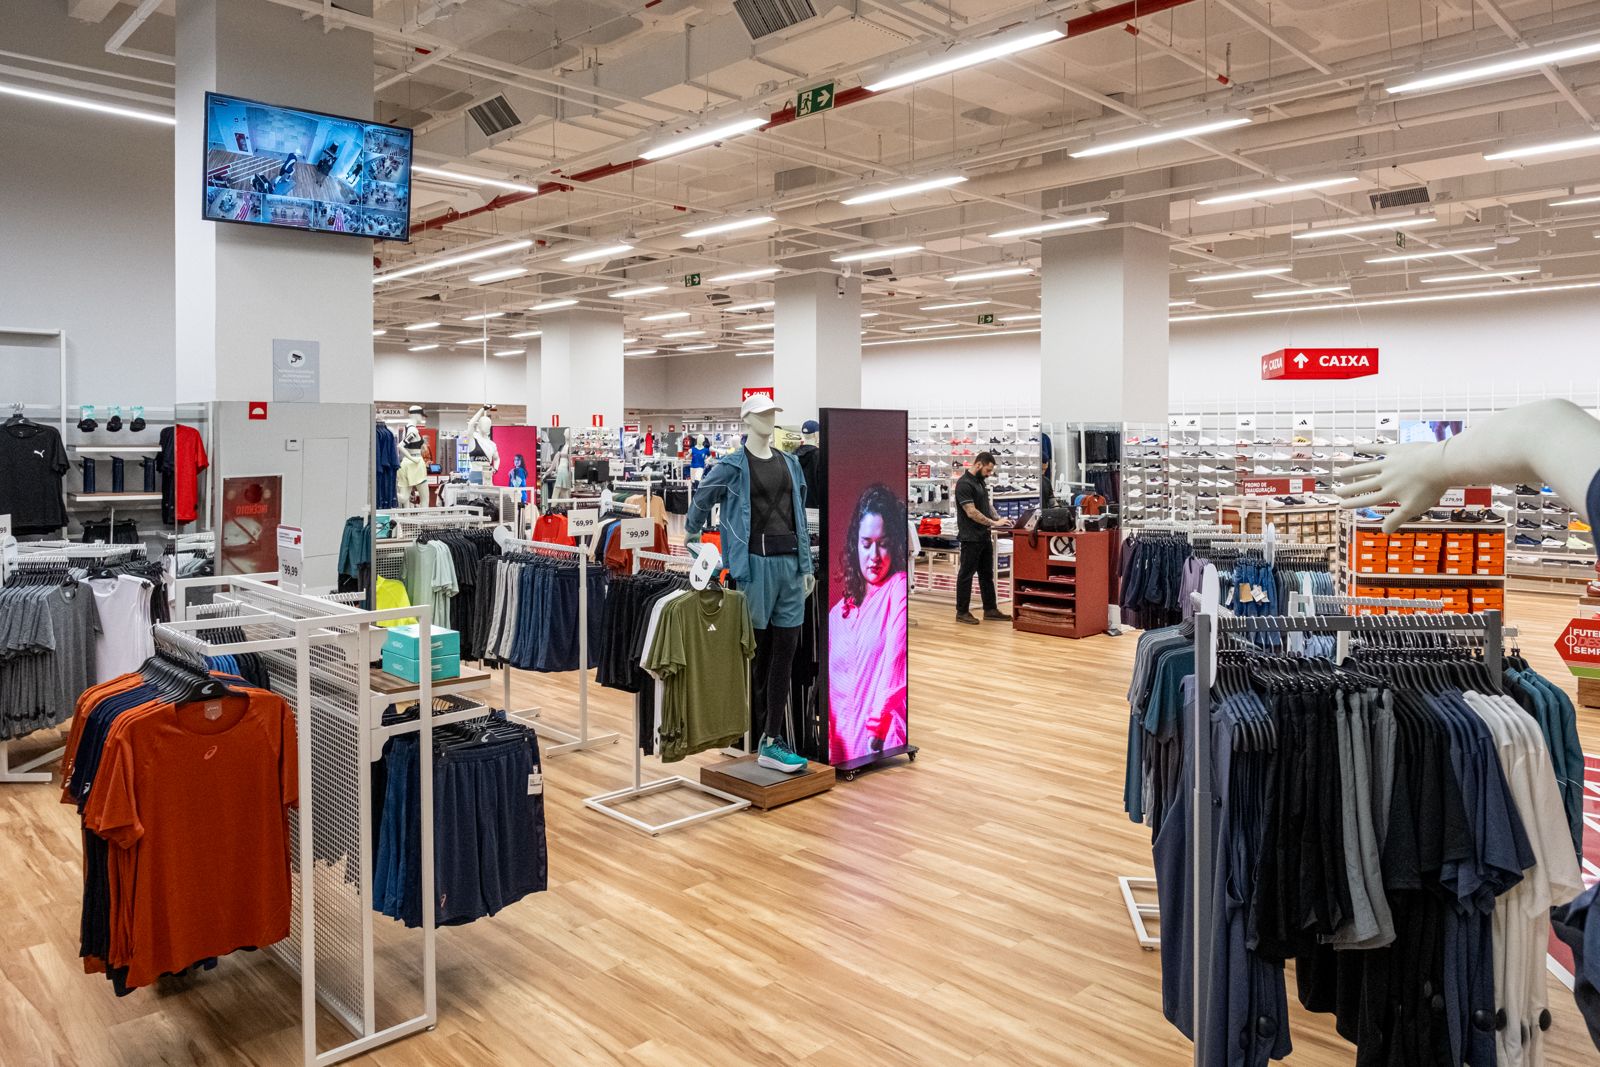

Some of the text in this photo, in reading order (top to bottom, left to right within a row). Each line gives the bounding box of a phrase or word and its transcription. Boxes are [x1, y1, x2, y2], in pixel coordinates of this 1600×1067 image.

[1269, 357, 1283, 371] CAIXA
[1318, 355, 1369, 367] CAIXA
[576, 519, 594, 527] 69,99
[629, 530, 649, 538] 99,99
[284, 564, 298, 577] 99,99
[1573, 628, 1600, 638] FUTE
